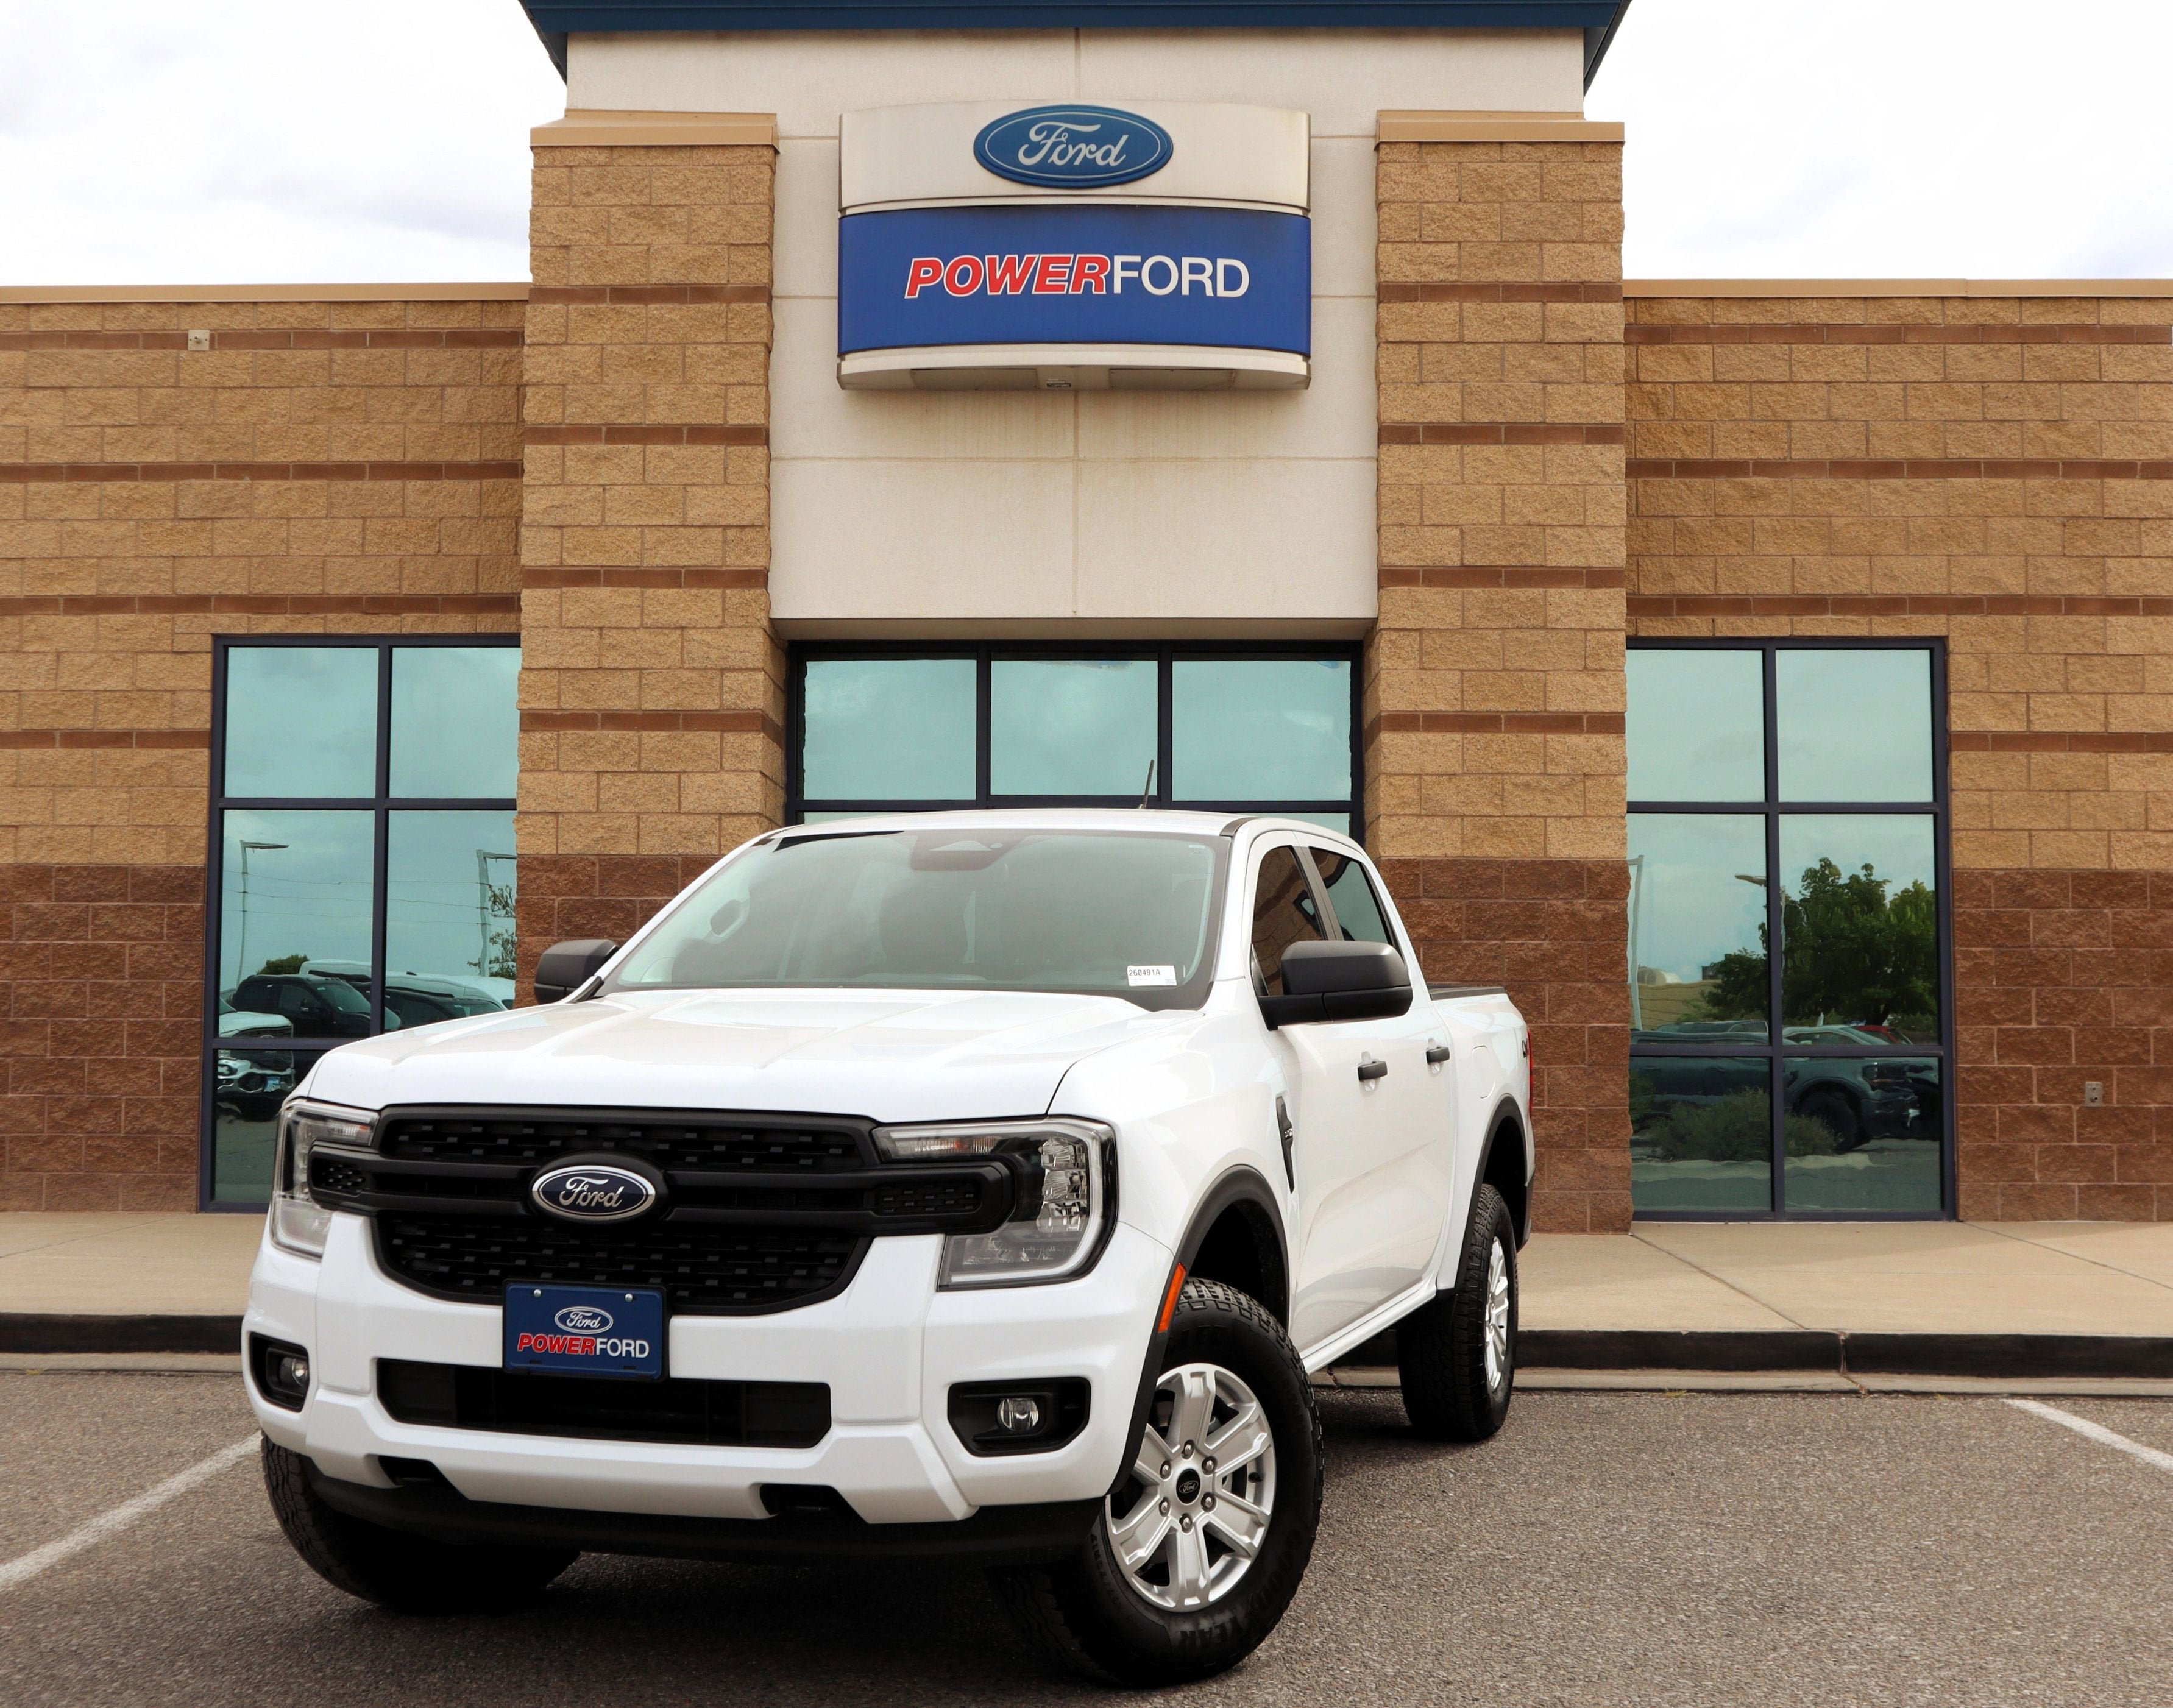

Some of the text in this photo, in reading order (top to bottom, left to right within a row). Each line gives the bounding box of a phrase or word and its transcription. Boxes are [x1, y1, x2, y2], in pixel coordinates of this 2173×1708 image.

[1018, 121, 1129, 168] Ford
[559, 1176, 625, 1208] Ford
[566, 1311, 601, 1329] Ford
